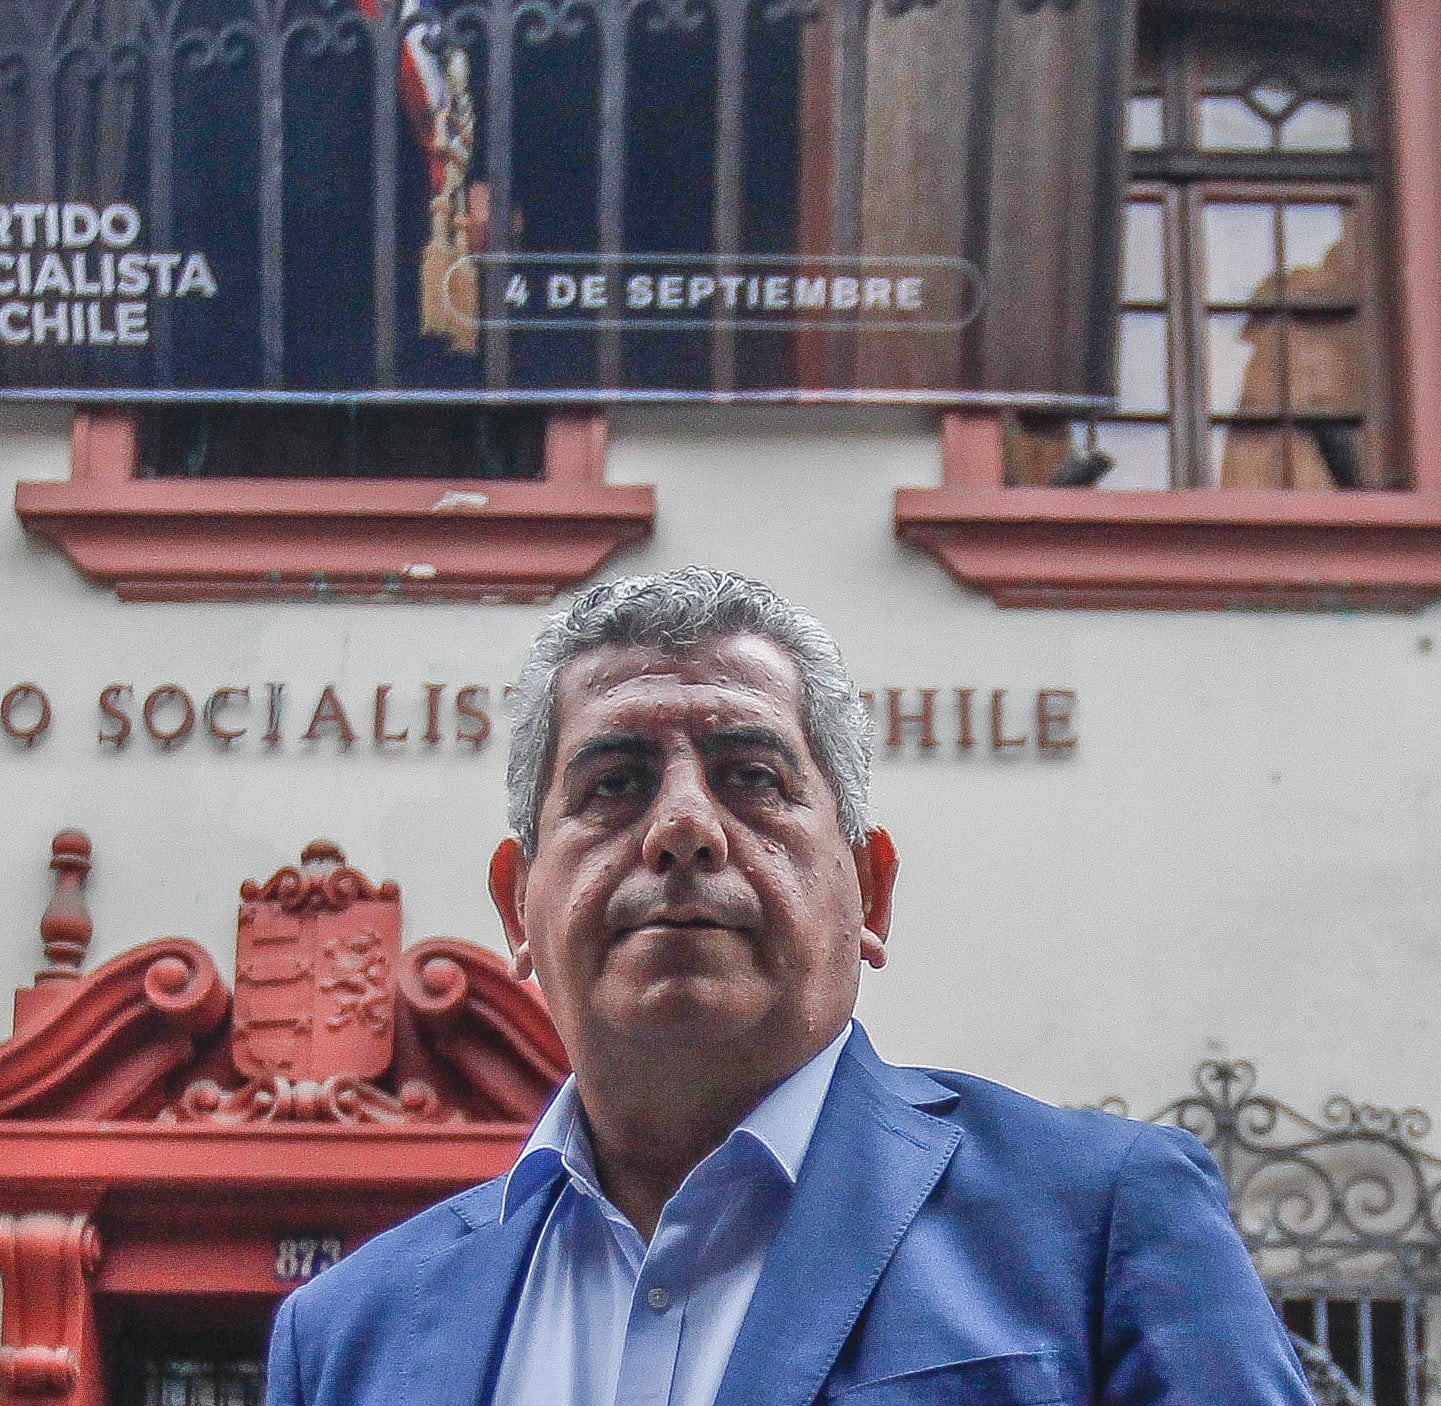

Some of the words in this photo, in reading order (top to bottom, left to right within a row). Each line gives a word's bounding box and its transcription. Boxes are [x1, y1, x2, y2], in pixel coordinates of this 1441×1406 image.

[504, 272, 529, 306] 4
[547, 274, 609, 308] DE
[625, 274, 925, 311] SEPTIEMBRE
[98, 682, 518, 748] SOCIALIS
[859, 687, 1079, 750] HILE
